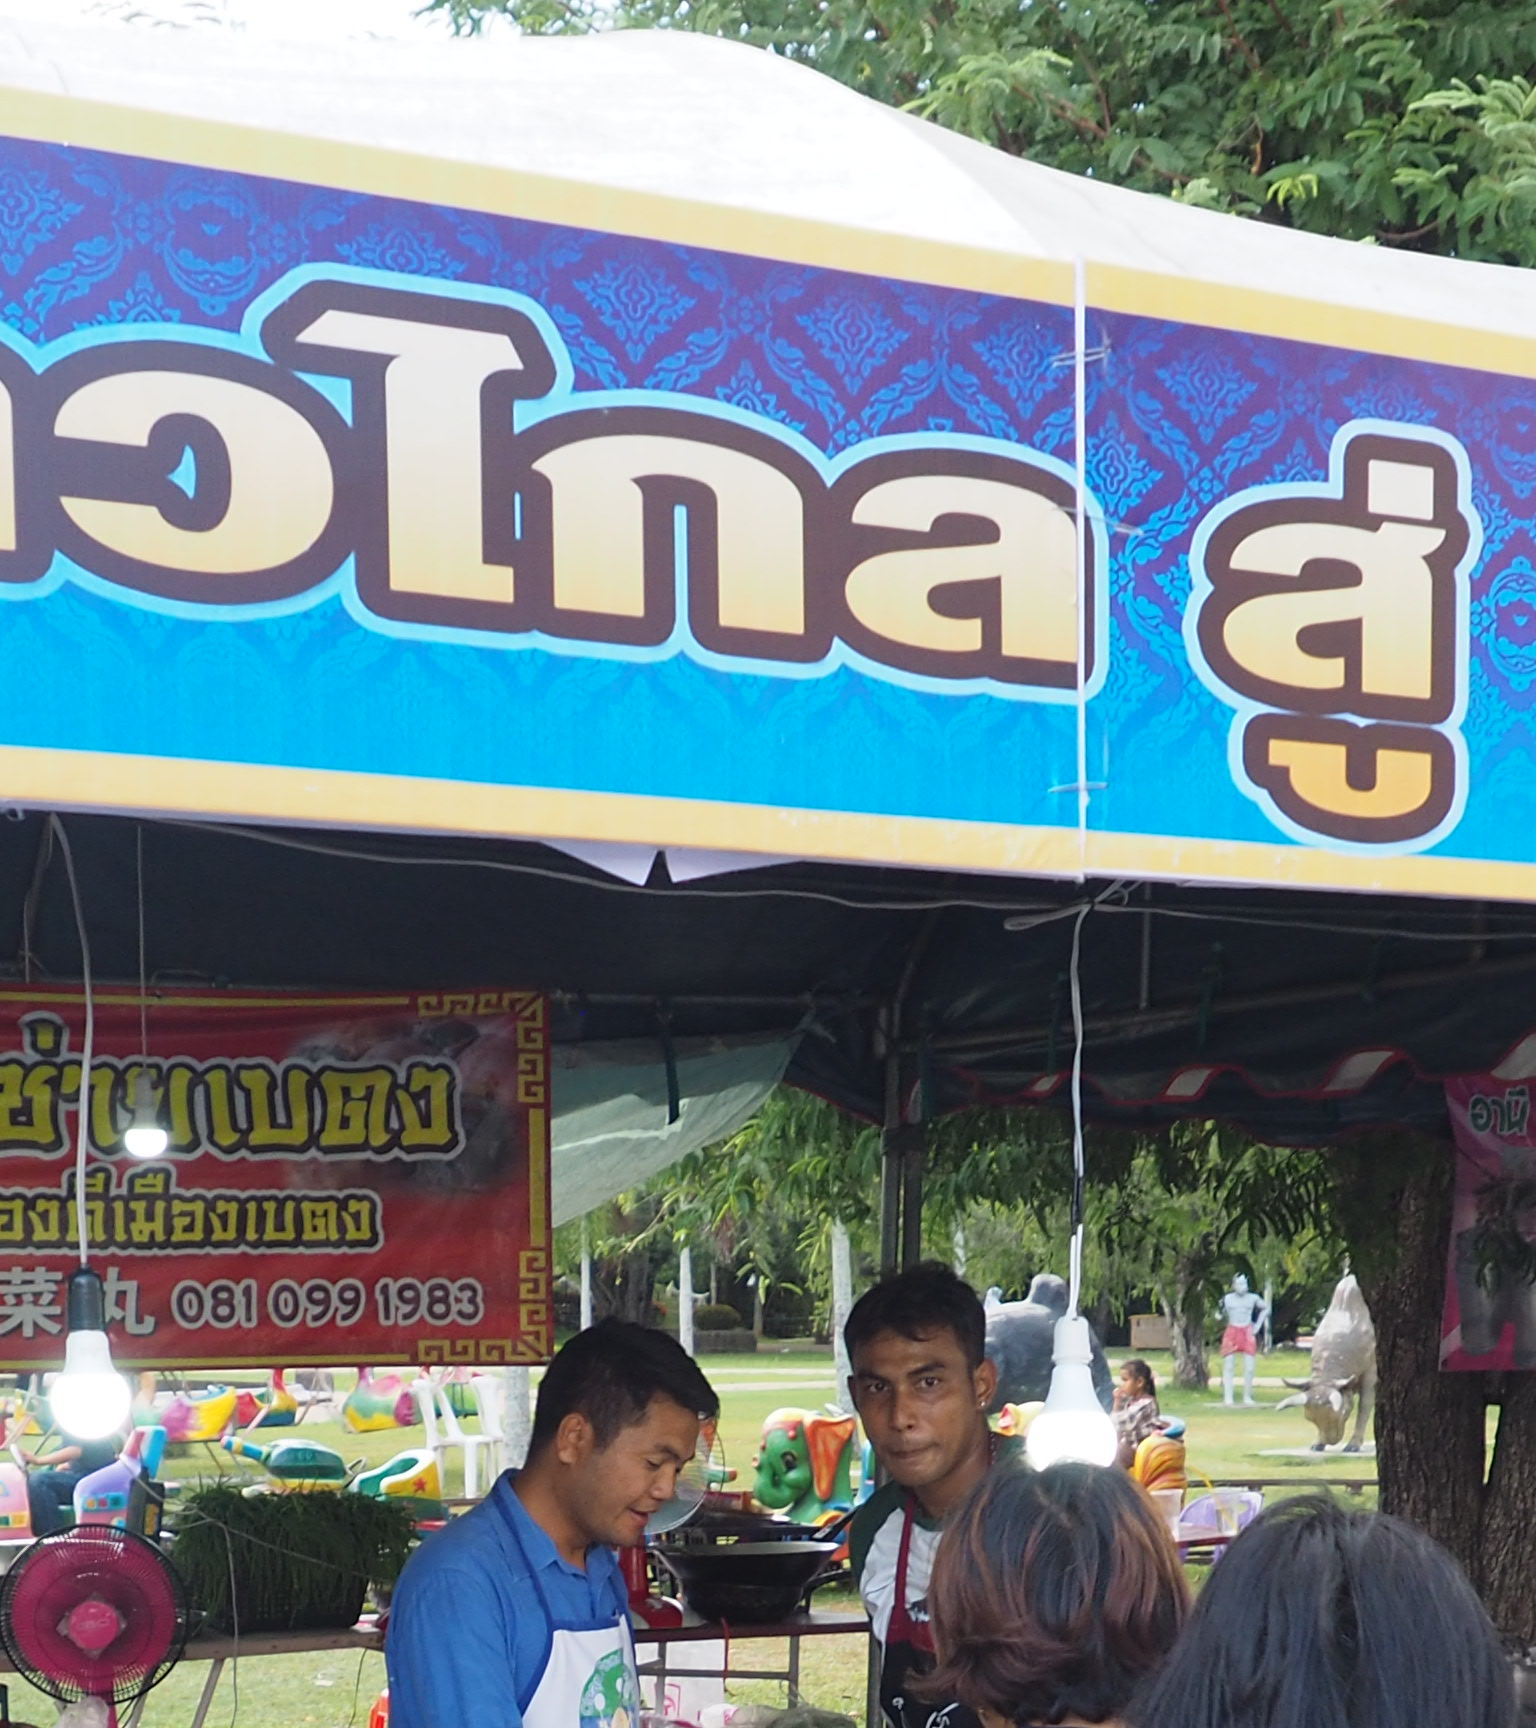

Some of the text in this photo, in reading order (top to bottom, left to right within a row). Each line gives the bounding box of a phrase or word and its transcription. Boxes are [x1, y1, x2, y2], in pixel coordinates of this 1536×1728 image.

[1209, 445, 1449, 832] สู่
[171, 1279, 255, 1328] 081
[268, 1279, 362, 1328] 099
[376, 1277, 484, 1328] 1983
